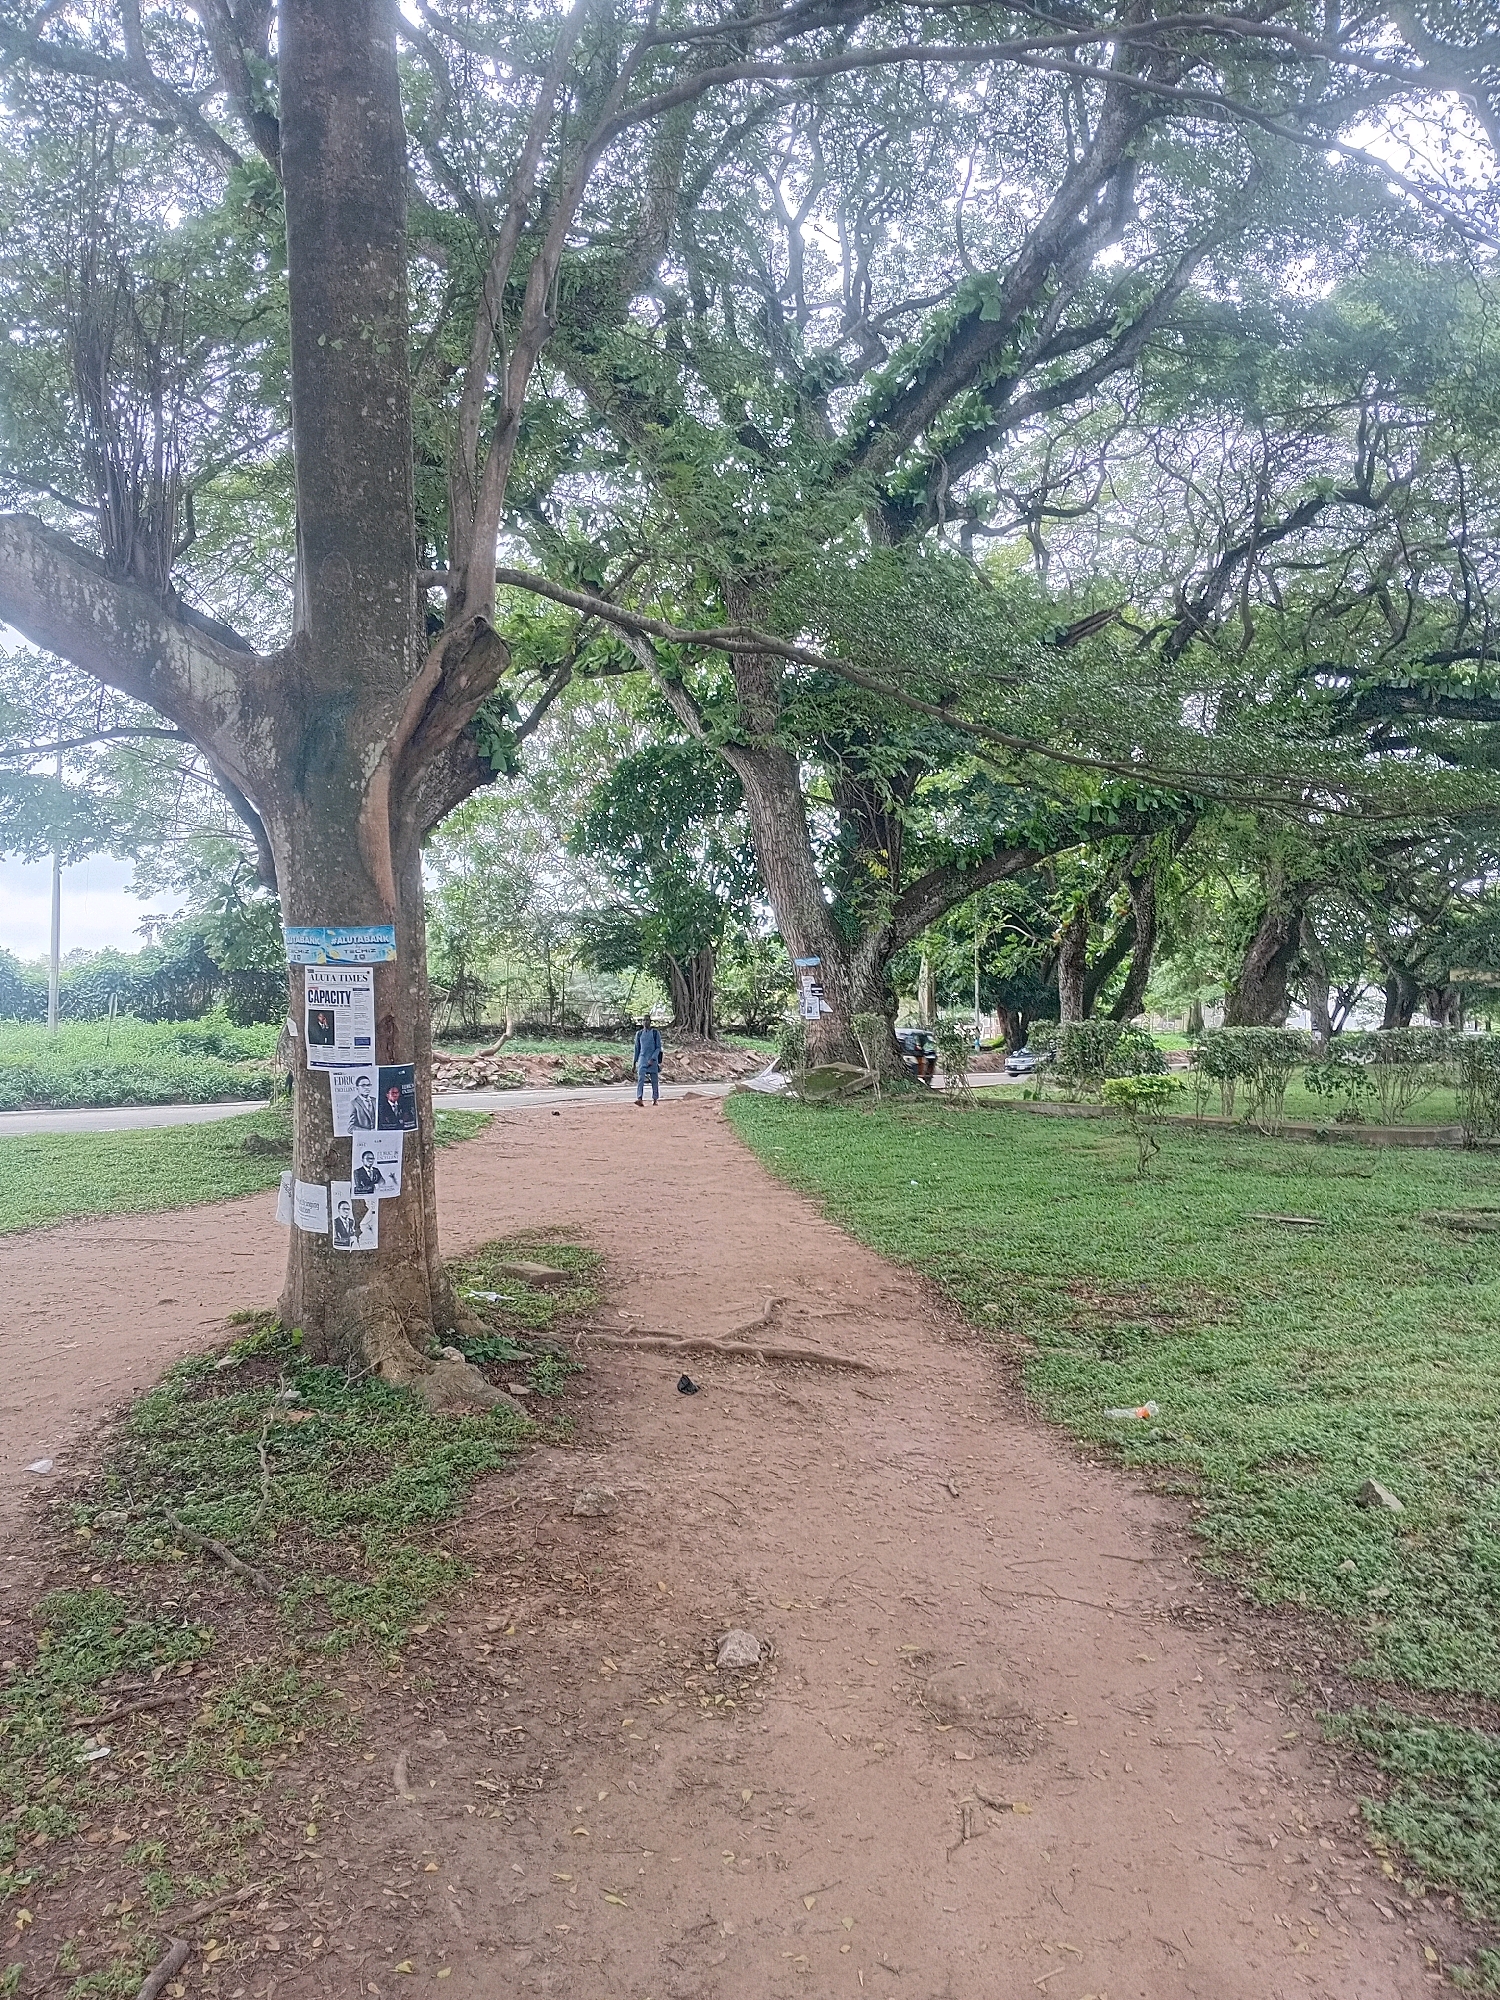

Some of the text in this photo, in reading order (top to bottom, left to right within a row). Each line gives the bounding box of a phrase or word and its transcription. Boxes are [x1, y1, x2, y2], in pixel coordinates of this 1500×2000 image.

[331, 935, 390, 946] #ALUTABANK
[309, 974, 368, 983] ALUTA TIMES
[308, 990, 351, 1004] CAPACITY
